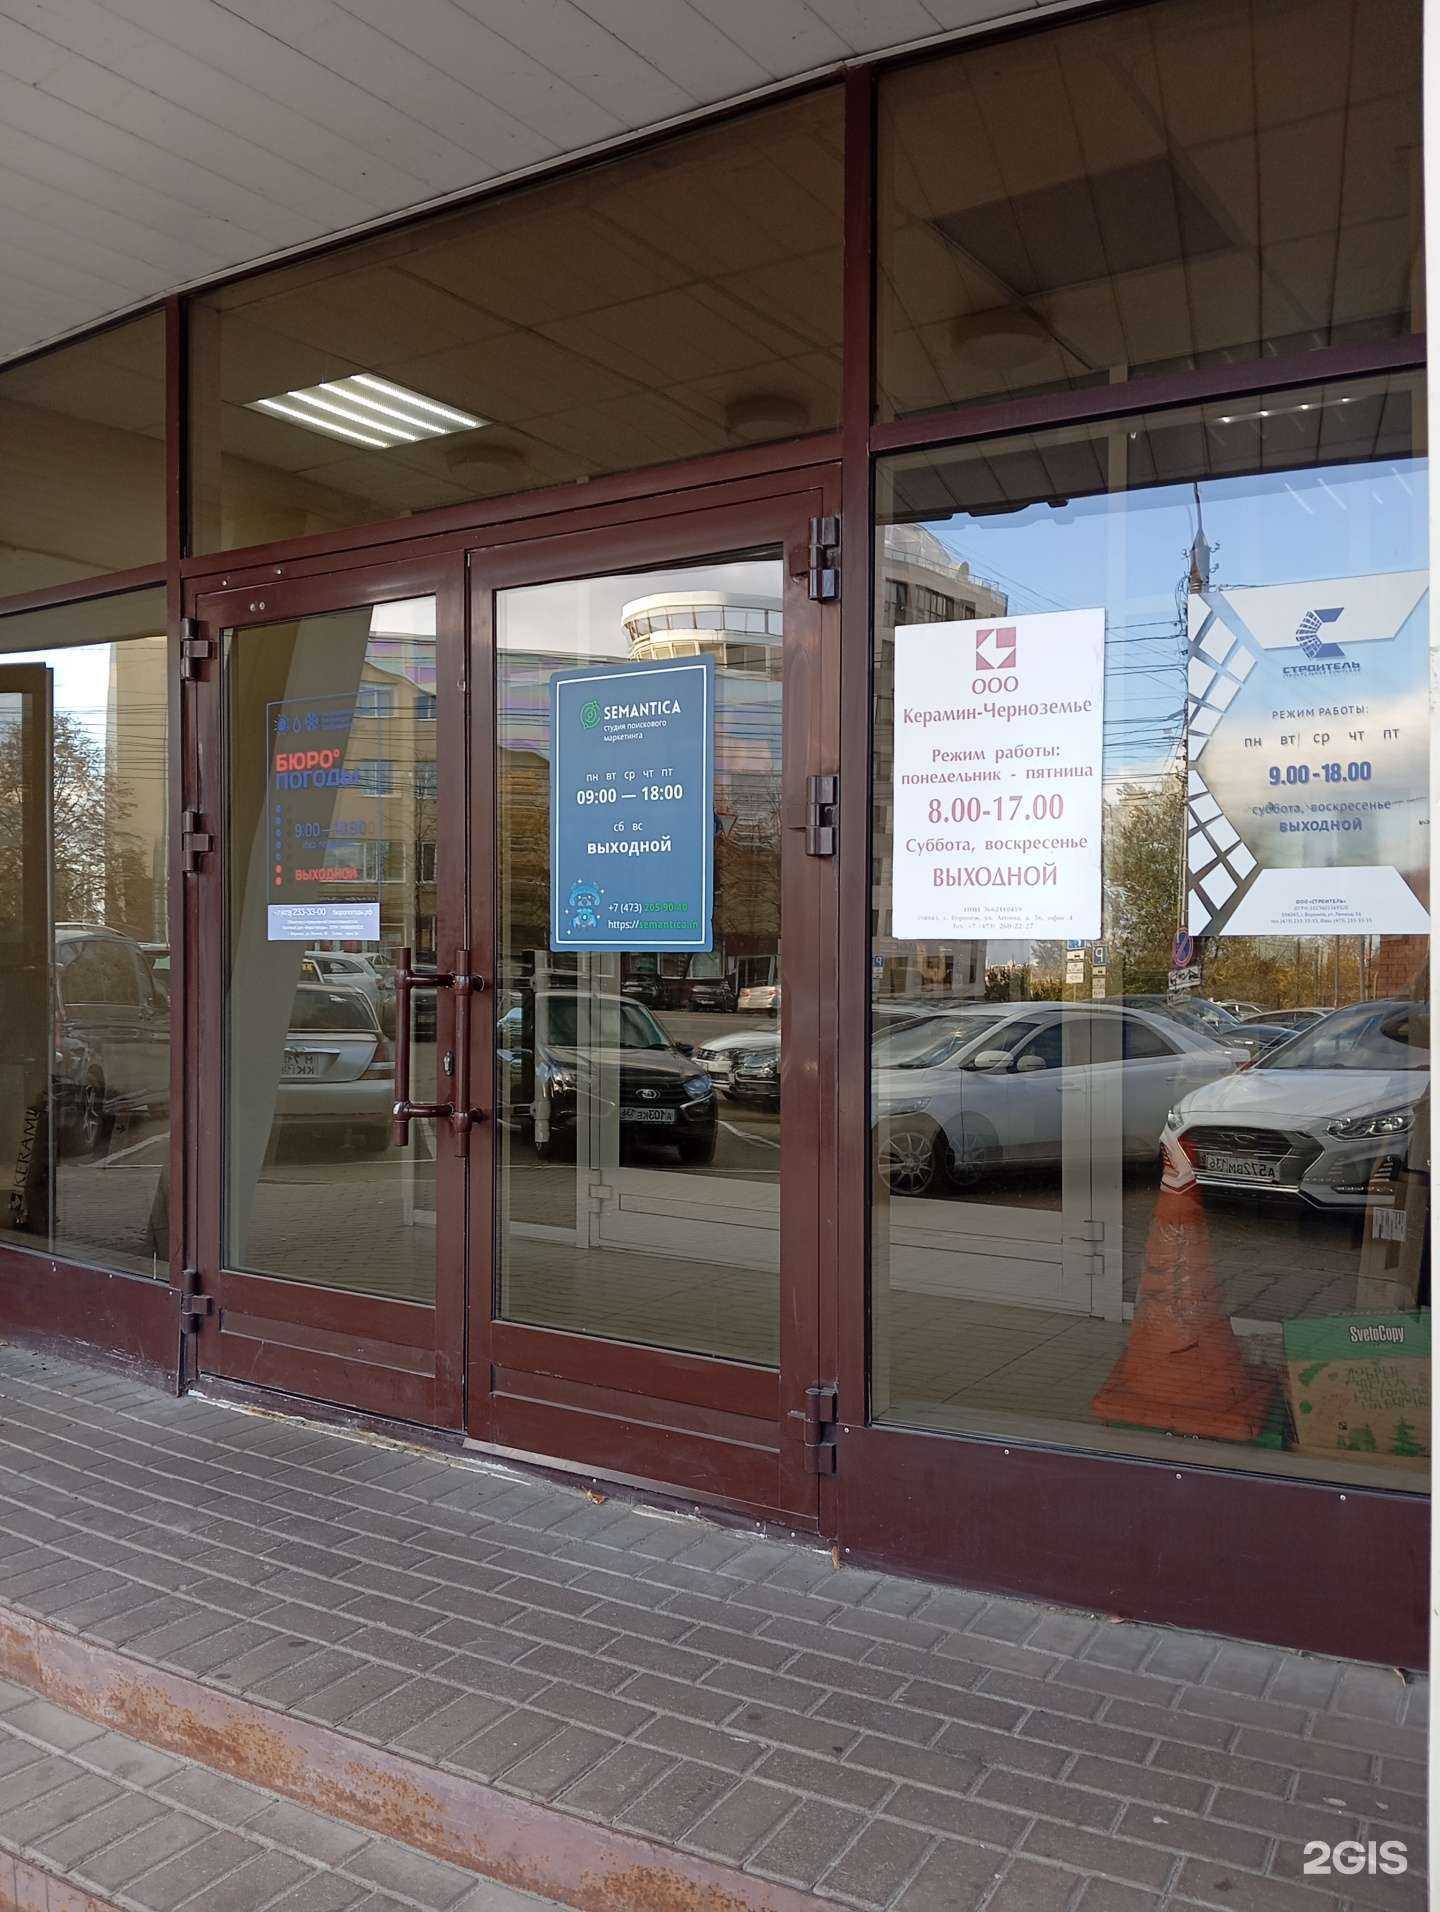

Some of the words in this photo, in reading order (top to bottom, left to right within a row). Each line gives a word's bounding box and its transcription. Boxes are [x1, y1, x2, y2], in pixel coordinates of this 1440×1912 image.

[1282, 661, 1361, 674] СТРОИТЕЛЬ
[972, 676, 1019, 695] ООО
[604, 699, 682, 720] SEMANTICA
[903, 699, 1093, 727] Керамин-Черноземье
[1272, 708, 1315, 719] РЕЖИМ
[1318, 705, 1369, 716] РАБОТЫ:
[603, 721, 626, 733] студия
[627, 719, 667, 731] поискового
[603, 732, 644, 742] маркетинга
[1244, 737, 1262, 748] пн
[1280, 735, 1296, 746] вт
[1313, 732, 1331, 746] ср
[1349, 730, 1365, 741] чт
[1383, 728, 1401, 740] пт
[932, 748, 986, 763] Режим
[995, 744, 1060, 763] работы:
[586, 772, 599, 782] пн
[606, 770, 617, 781] вт
[624, 769, 636, 782] ср
[643, 768, 654, 778] чт
[661, 767, 673, 777] пт
[901, 771, 1001, 785] понедельник
[1026, 766, 1093, 779] пятница
[577, 788, 617, 805] 09:00
[641, 784, 683, 801] 18:00
[928, 794, 1064, 823] 8.00-17.00
[1310, 800, 1392, 813] воскресенье
[613, 821, 625, 832] сб
[632, 821, 643, 831] вс
[905, 837, 976, 856] Суббота,
[985, 836, 1088, 854] воскресенье
[933, 862, 1057, 887] ВЫХОДНОЙ
[608, 903, 618, 912] +7
[620, 902, 642, 914] (473)
[1350, 1324, 1404, 1343] SvetoCopy
